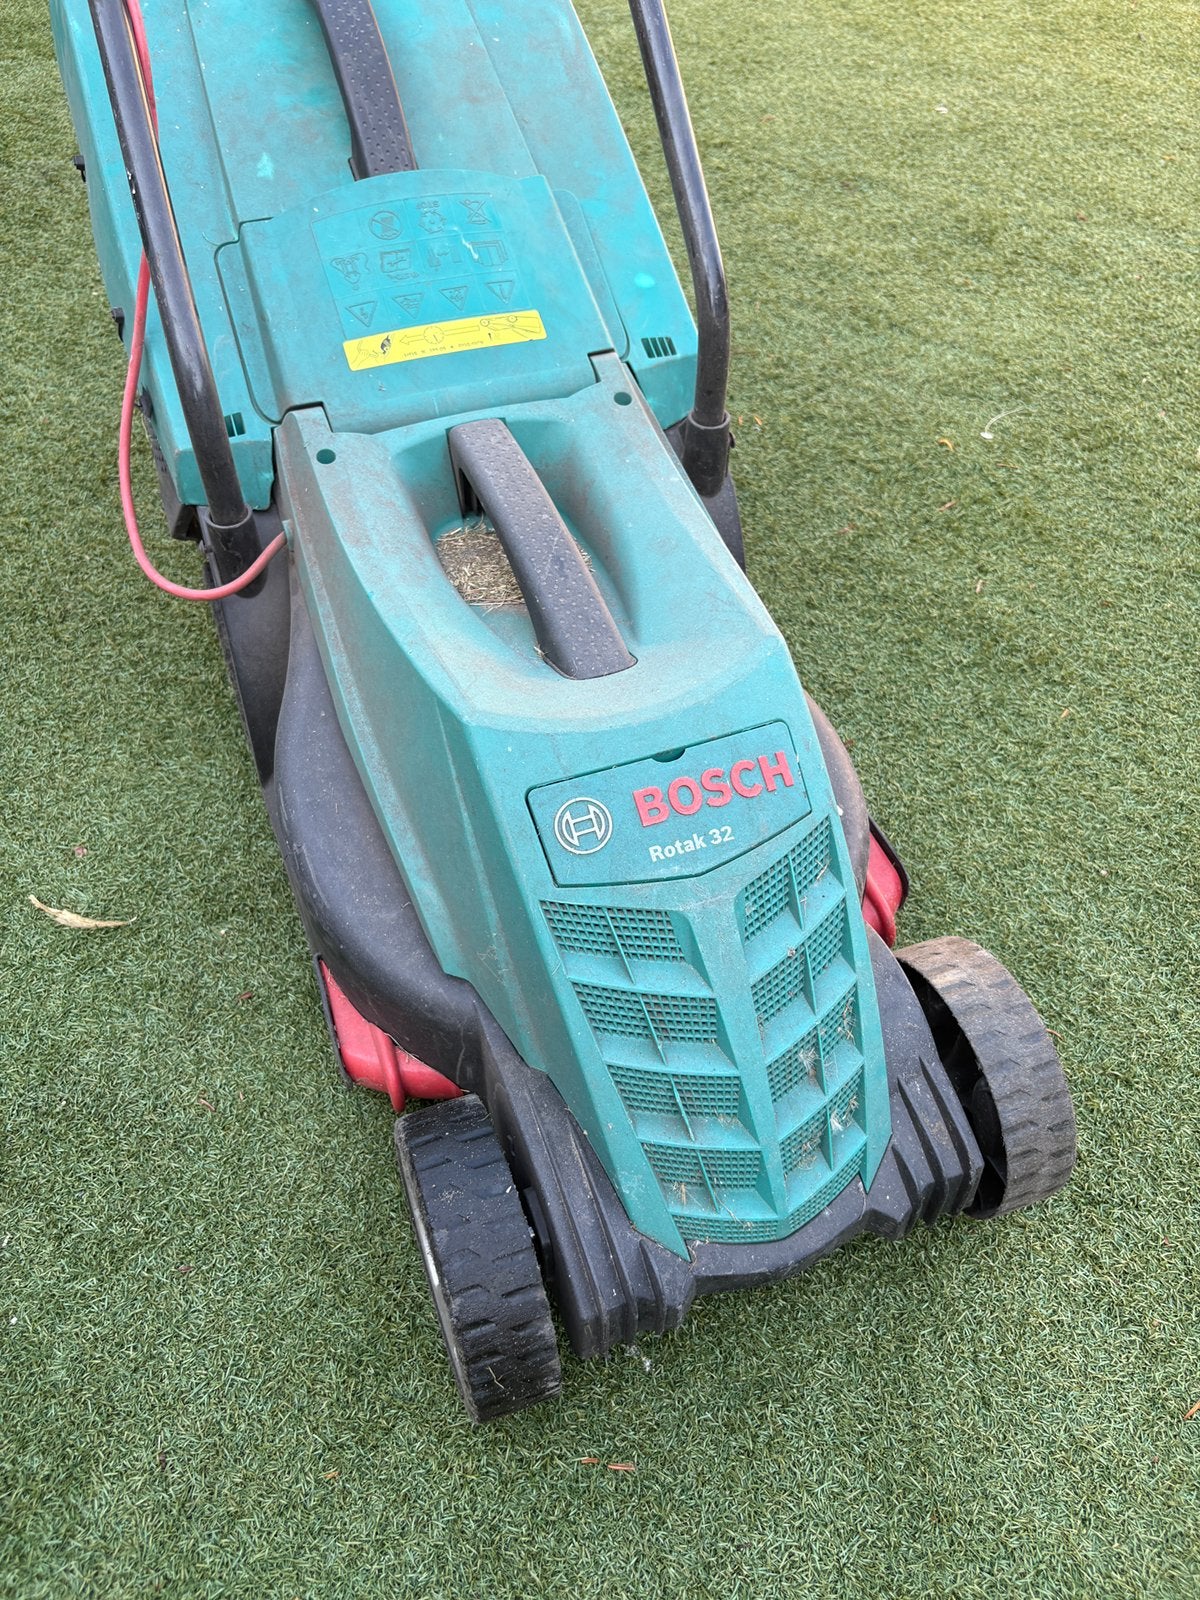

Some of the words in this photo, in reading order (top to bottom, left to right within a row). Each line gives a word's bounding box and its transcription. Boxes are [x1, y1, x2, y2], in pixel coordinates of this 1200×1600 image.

[633, 751, 795, 827] BOSCH
[648, 835, 707, 862] Rotak
[708, 825, 735, 845] 32
